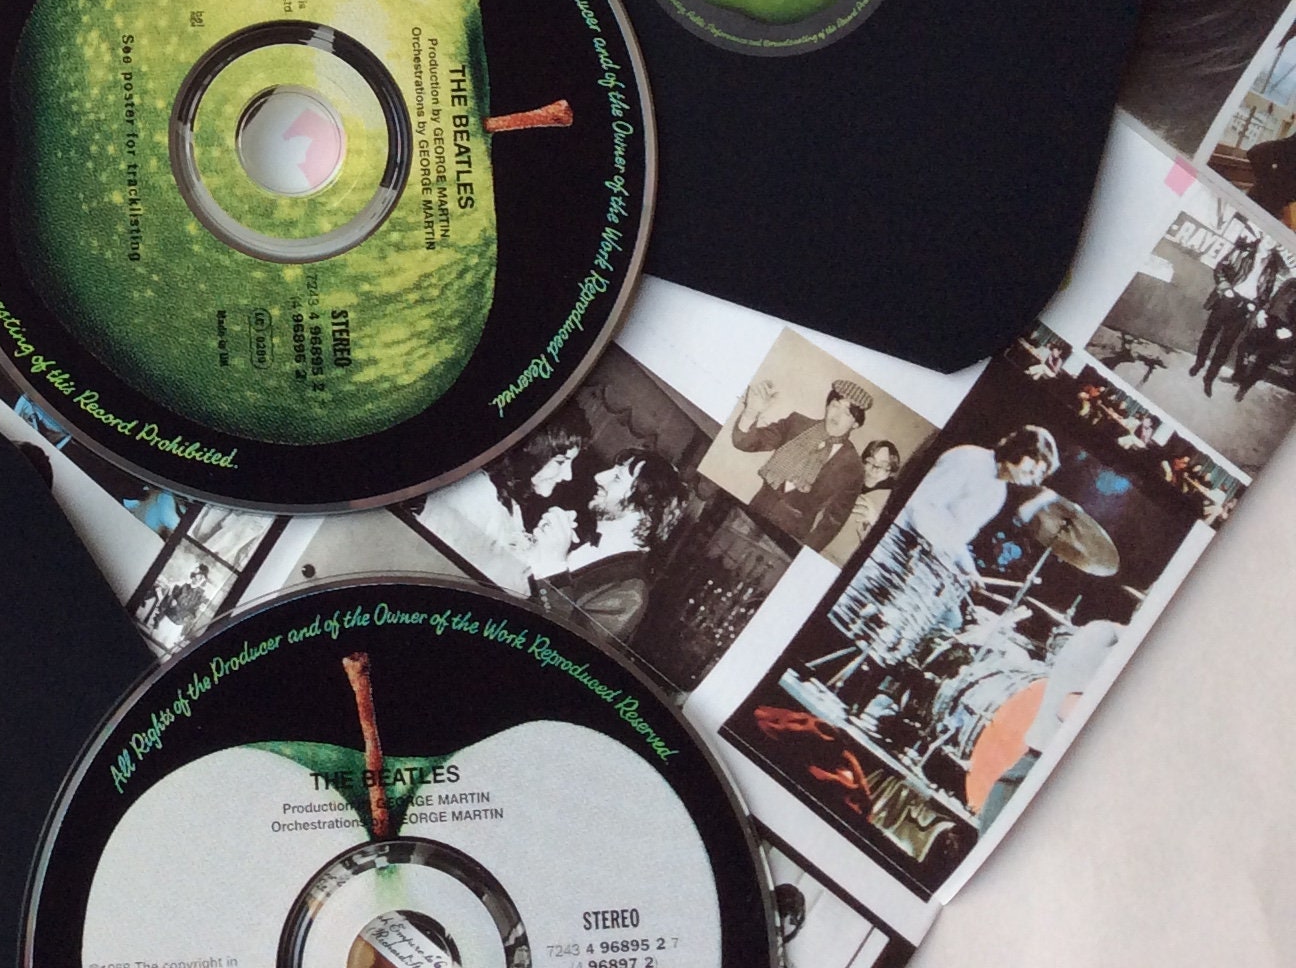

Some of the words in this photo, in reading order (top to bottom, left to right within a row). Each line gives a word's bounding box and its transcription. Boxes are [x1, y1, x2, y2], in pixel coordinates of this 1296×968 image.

[122, 34, 135, 64] See
[593, 37, 622, 71] and
[411, 26, 425, 118] Orchestrations
[427, 38, 440, 105] Production
[449, 64, 468, 107] THE
[598, 72, 626, 89] of
[121, 71, 136, 126] poster
[431, 108, 442, 124] by
[608, 90, 631, 117] the
[124, 133, 139, 156] for
[415, 121, 426, 136] by
[611, 120, 634, 174] Owner
[418, 139, 432, 195] GEORGE
[432, 129, 447, 184] GEORGE
[452, 115, 475, 210] BEATLES
[604, 175, 630, 197] of
[126, 164, 142, 262] tracklisting
[421, 199, 436, 251] MARTIN
[436, 188, 450, 238] MARTIN
[606, 195, 629, 224] the
[594, 226, 623, 272] Work
[546, 269, 610, 363] Reproduced
[330, 309, 352, 367] STEREO
[30, 355, 56, 373] of
[46, 368, 77, 395] this
[73, 389, 139, 436] Record
[136, 422, 239, 469] Prohibited.
[109, 748, 137, 794] All
[128, 707, 176, 761] Rights
[172, 688, 192, 718] of
[186, 672, 212, 701] the
[209, 634, 284, 684] Producer
[287, 615, 322, 644] and
[324, 609, 341, 640] of
[342, 605, 371, 628] the
[373, 602, 428, 626] Owner
[429, 609, 453, 635] of
[451, 611, 480, 635] the
[483, 618, 530, 649] Work
[528, 633, 622, 703] Reproduced
[309, 770, 354, 791] THE
[361, 764, 461, 787] BEATLES
[271, 817, 365, 833] Orchestrations
[451, 807, 505, 822] MARTIN
[282, 800, 355, 815] Production
[437, 792, 491, 806] MARTIN
[583, 908, 640, 931] STEREO
[226, 956, 238, 967] in
[546, 943, 581, 958] 7243
[585, 943, 595, 955] 4
[599, 938, 650, 954] 96895
[655, 936, 666, 951] 2
[671, 936, 679, 949] 7
